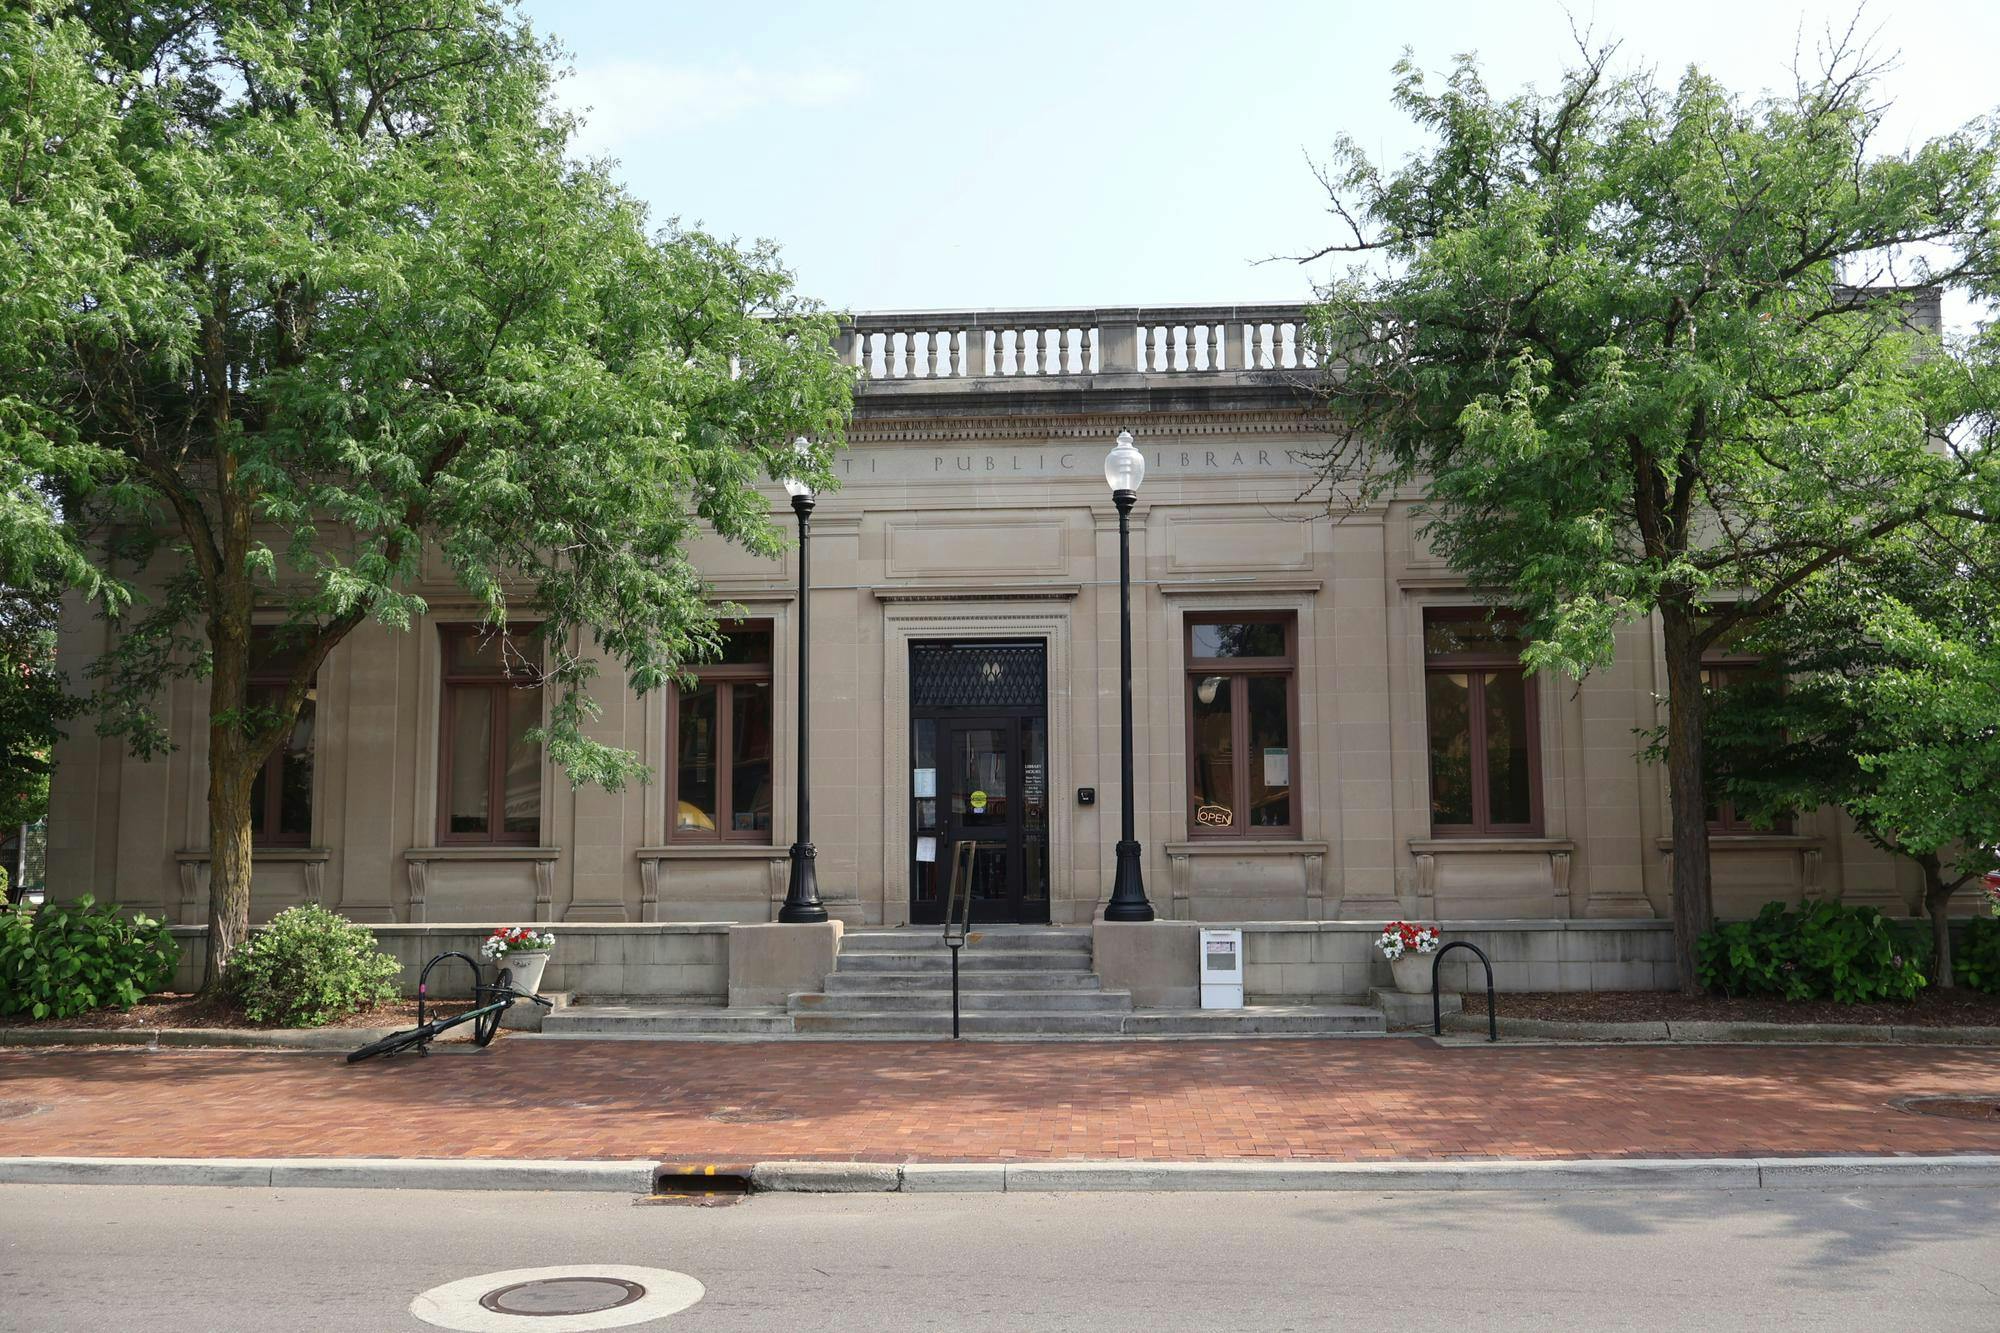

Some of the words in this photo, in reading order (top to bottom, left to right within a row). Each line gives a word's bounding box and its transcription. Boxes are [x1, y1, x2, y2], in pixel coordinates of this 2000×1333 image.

[934, 453, 1074, 472] PUBLIC
[1156, 450, 1297, 468] IBRAR
[1199, 811, 1231, 825] OPEN
